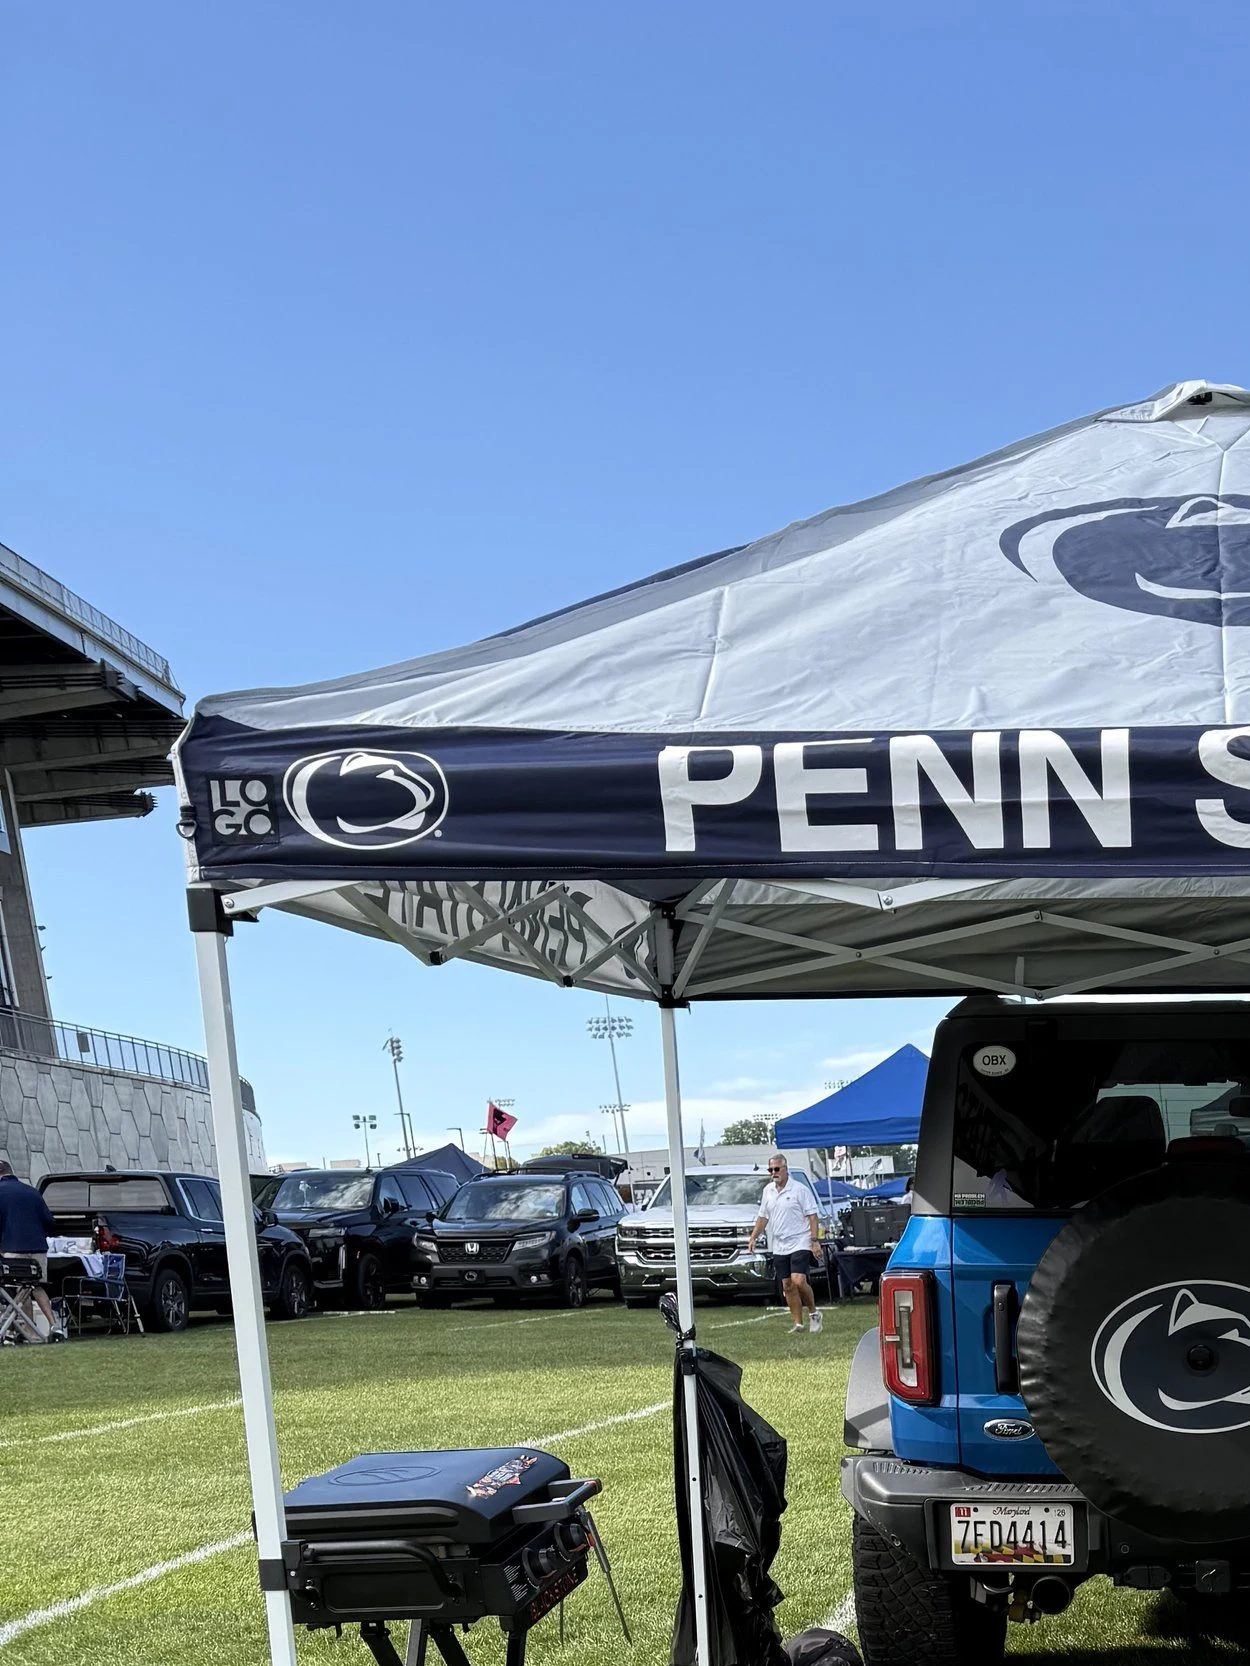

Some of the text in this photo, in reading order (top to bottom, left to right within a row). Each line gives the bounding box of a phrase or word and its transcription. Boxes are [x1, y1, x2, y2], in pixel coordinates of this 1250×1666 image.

[657, 729, 1132, 853] PENN
[982, 1055, 1006, 1065] OBX
[995, 1422, 1022, 1435] Ford
[993, 1506, 1031, 1518] Maryland
